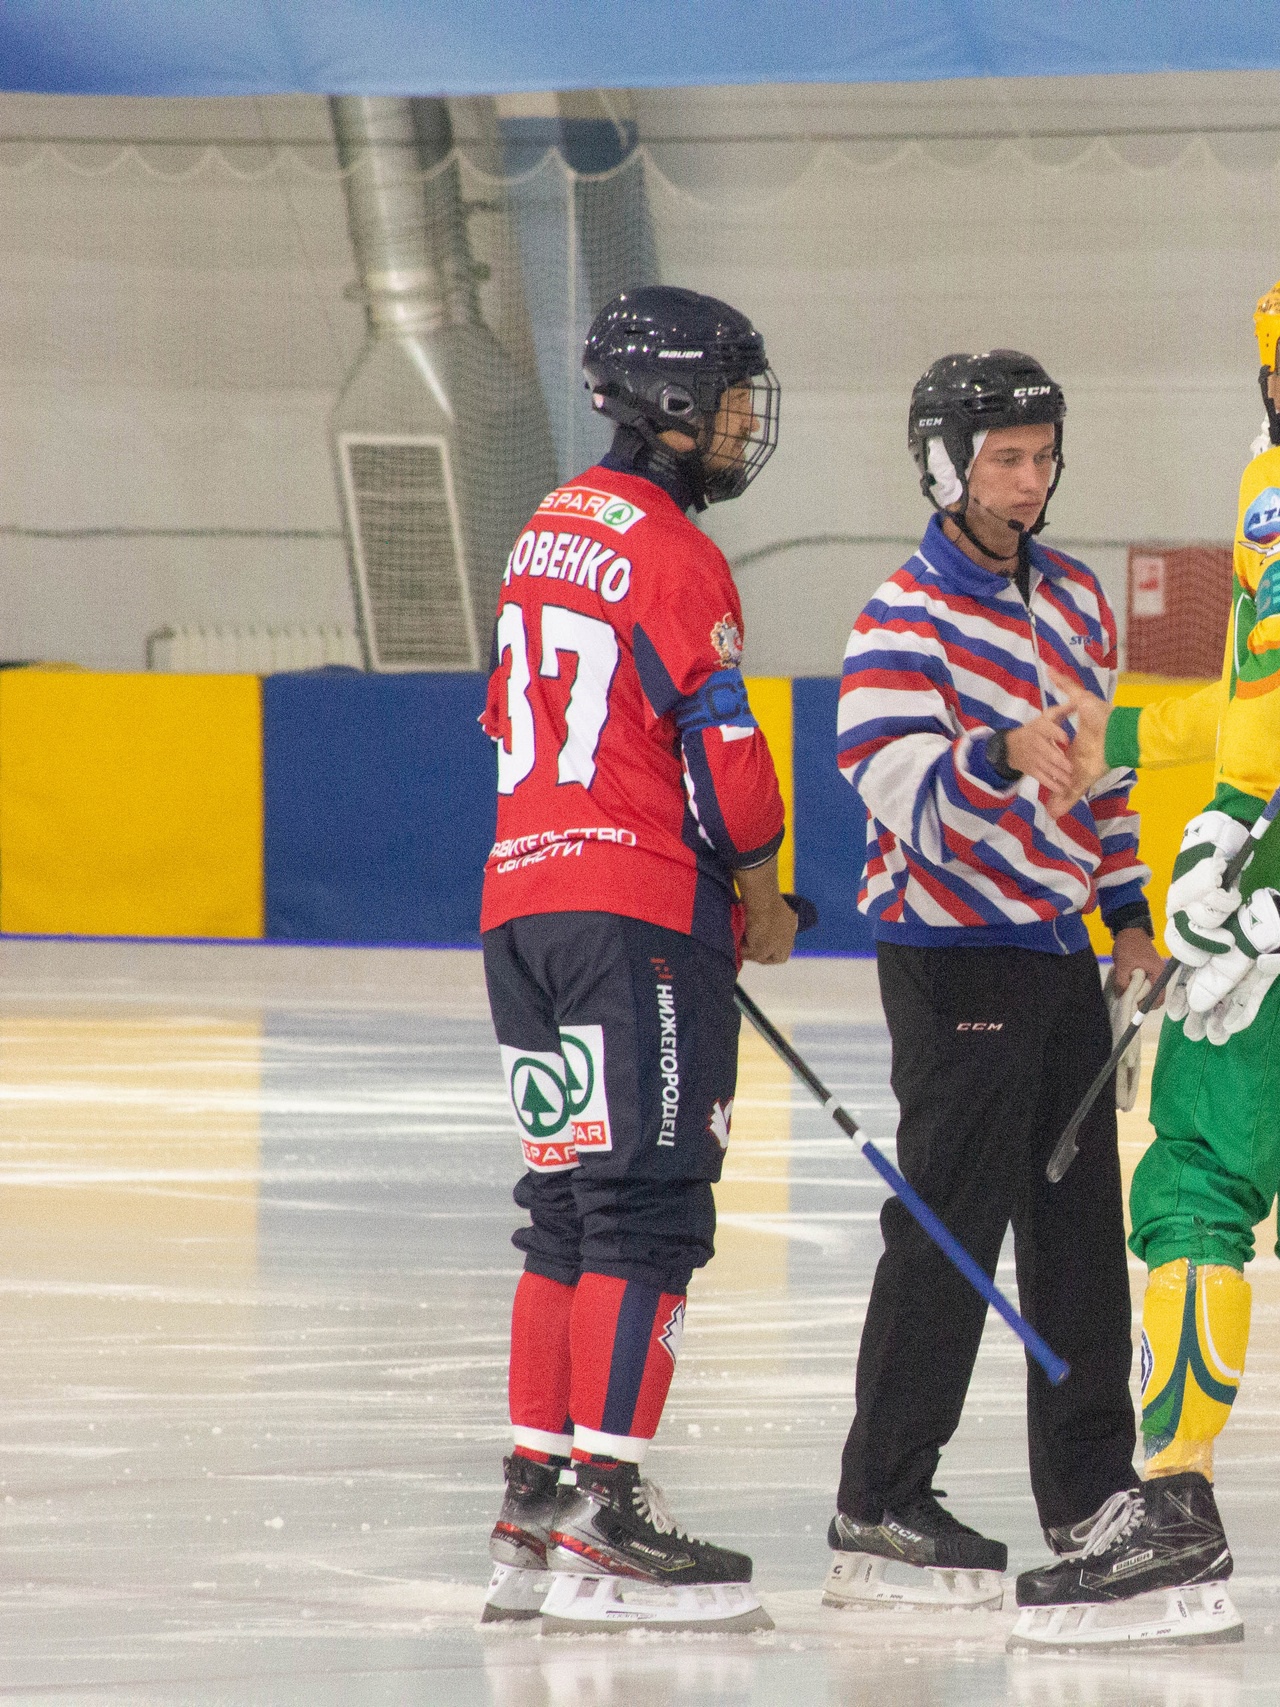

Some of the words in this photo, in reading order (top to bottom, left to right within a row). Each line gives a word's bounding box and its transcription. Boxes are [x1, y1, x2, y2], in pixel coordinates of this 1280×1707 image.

[657, 350, 704, 359] BAUER
[1013, 385, 1051, 398] CCM
[918, 417, 943, 428] CCM
[539, 491, 606, 514] SPAR
[956, 1022, 1004, 1031] CCM
[656, 983, 681, 1148] НИЖЕГОРОДЕЦ
[888, 1521, 923, 1543] CCM
[1114, 1551, 1152, 1571] BAUER
